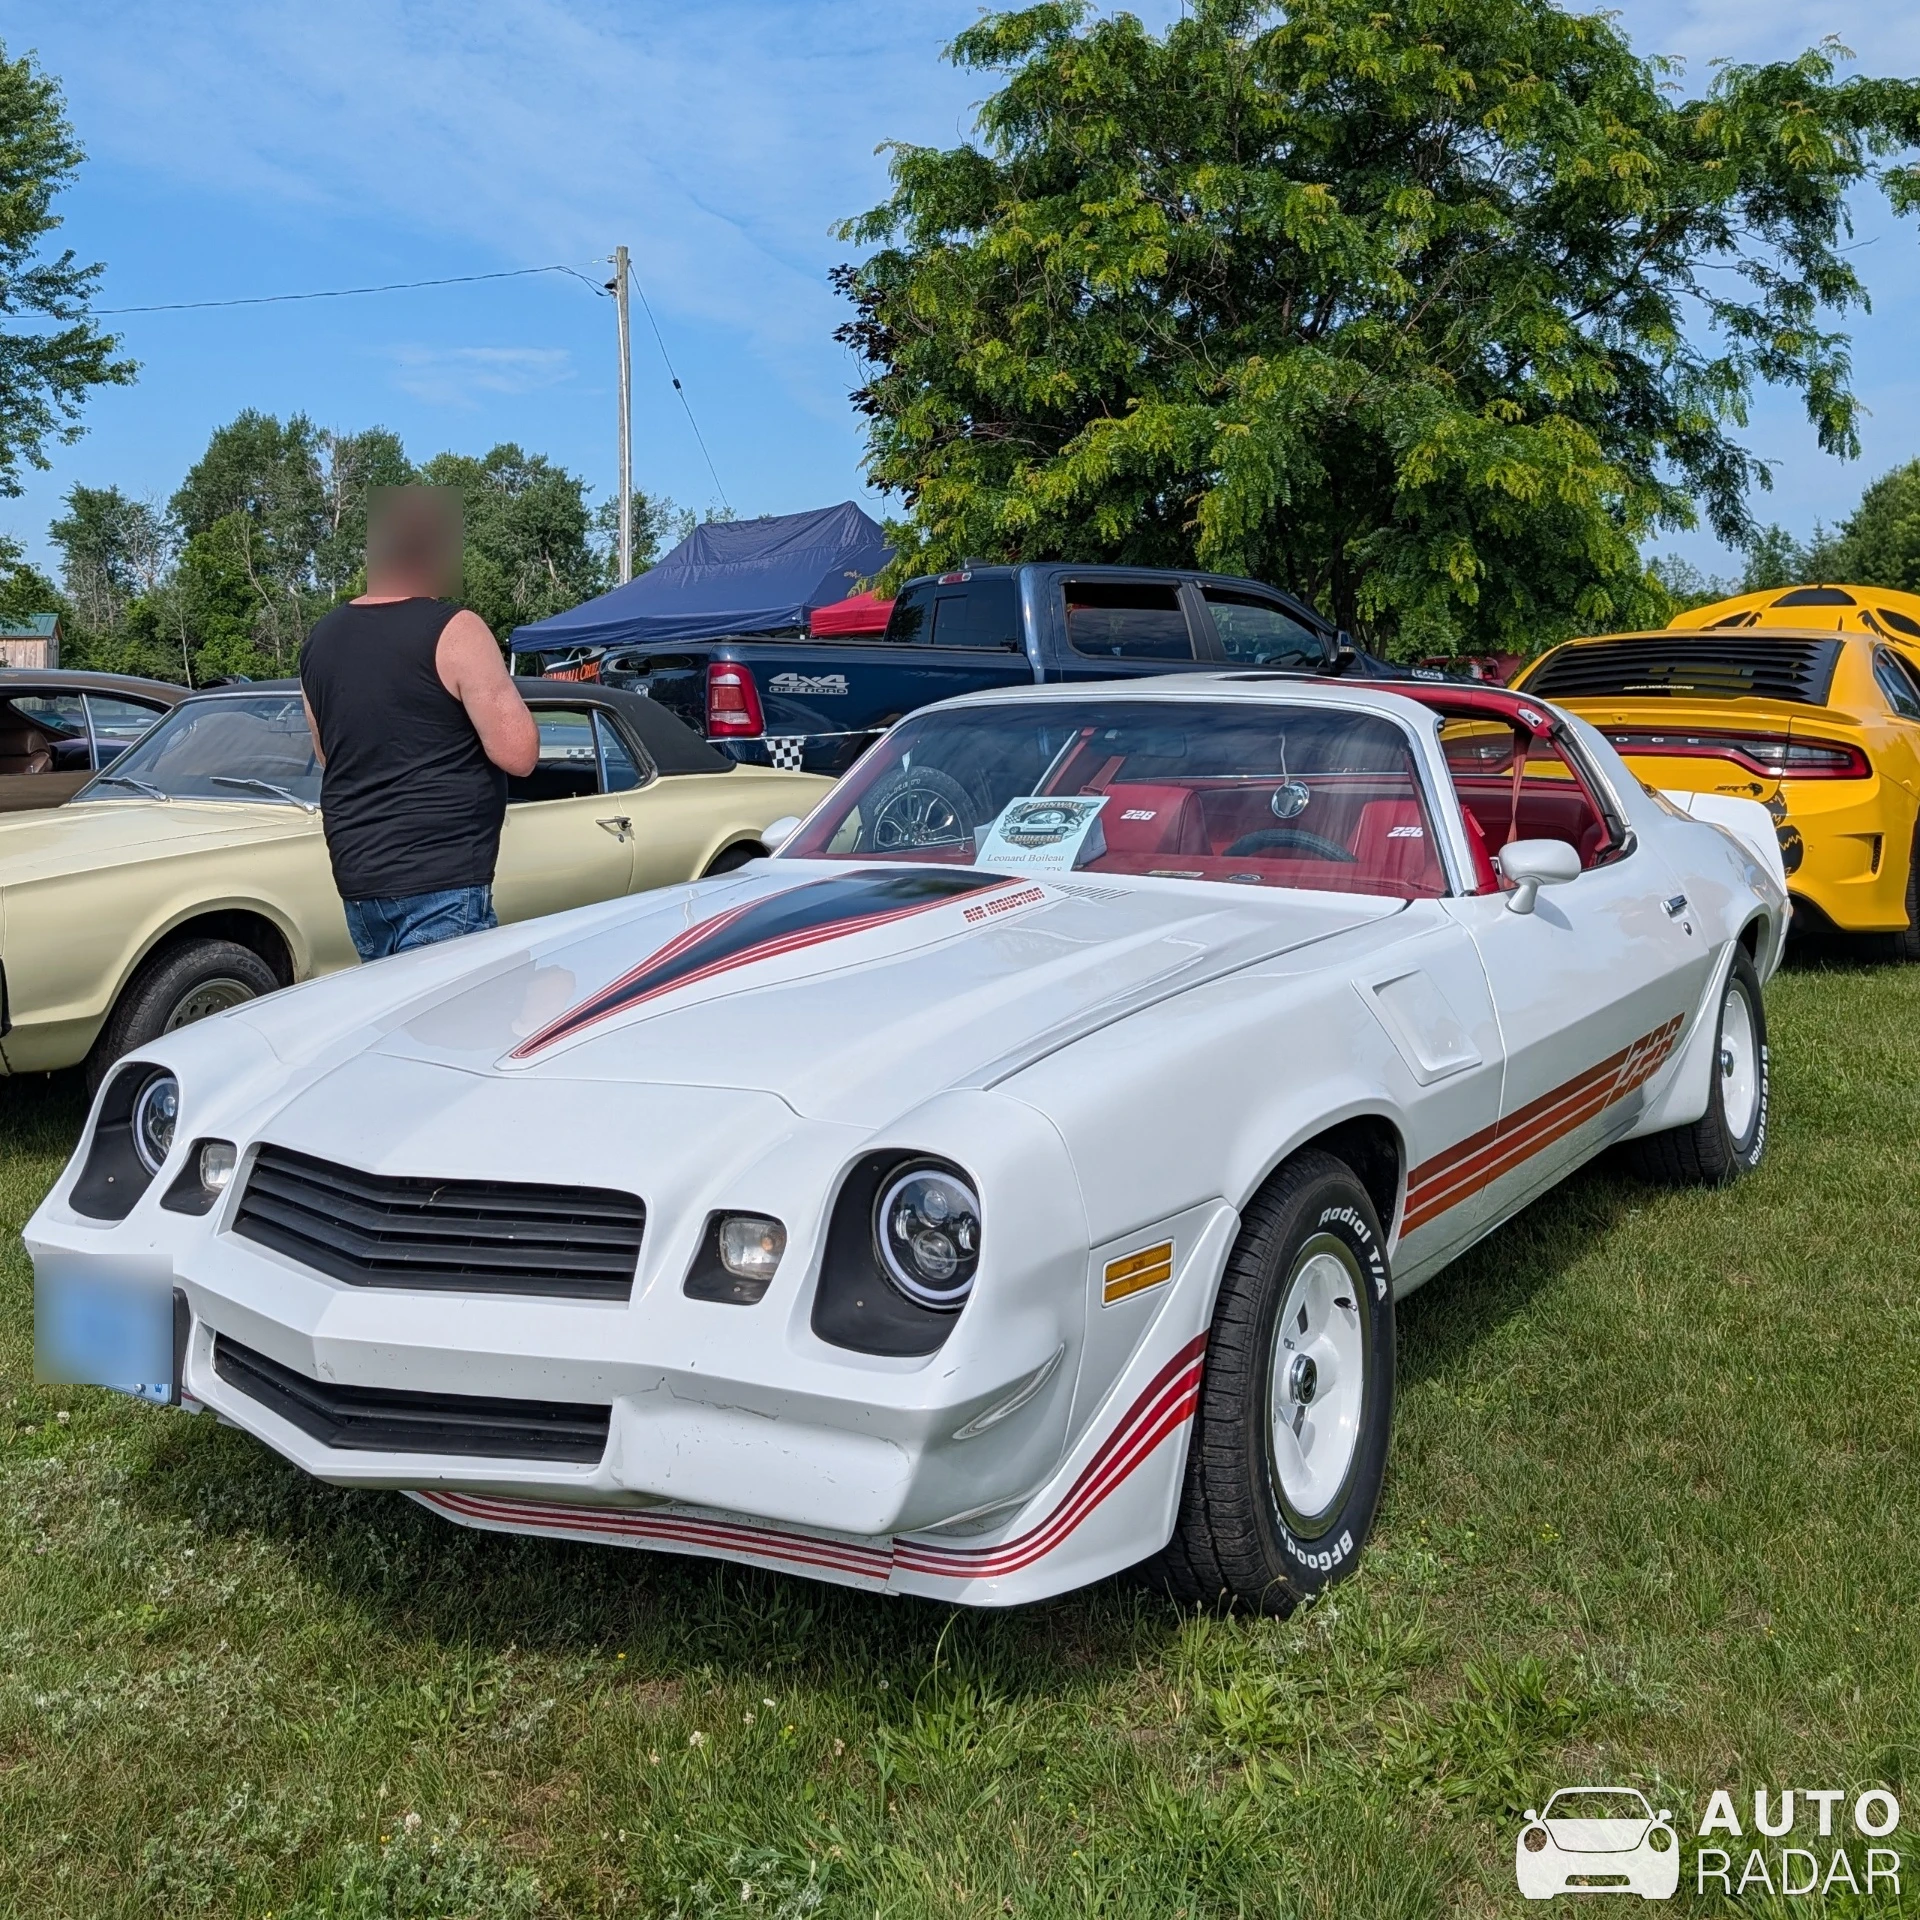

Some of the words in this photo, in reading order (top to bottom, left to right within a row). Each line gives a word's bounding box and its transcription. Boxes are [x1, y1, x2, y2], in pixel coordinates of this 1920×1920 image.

[1022, 801, 1085, 811] CORNWALL
[987, 854, 1027, 862] Leonard
[1028, 854, 1064, 862] Boileau
[962, 905, 987, 923] AIR
[984, 886, 1045, 915] INDUCTION
[1318, 1205, 1372, 1243] Radial
